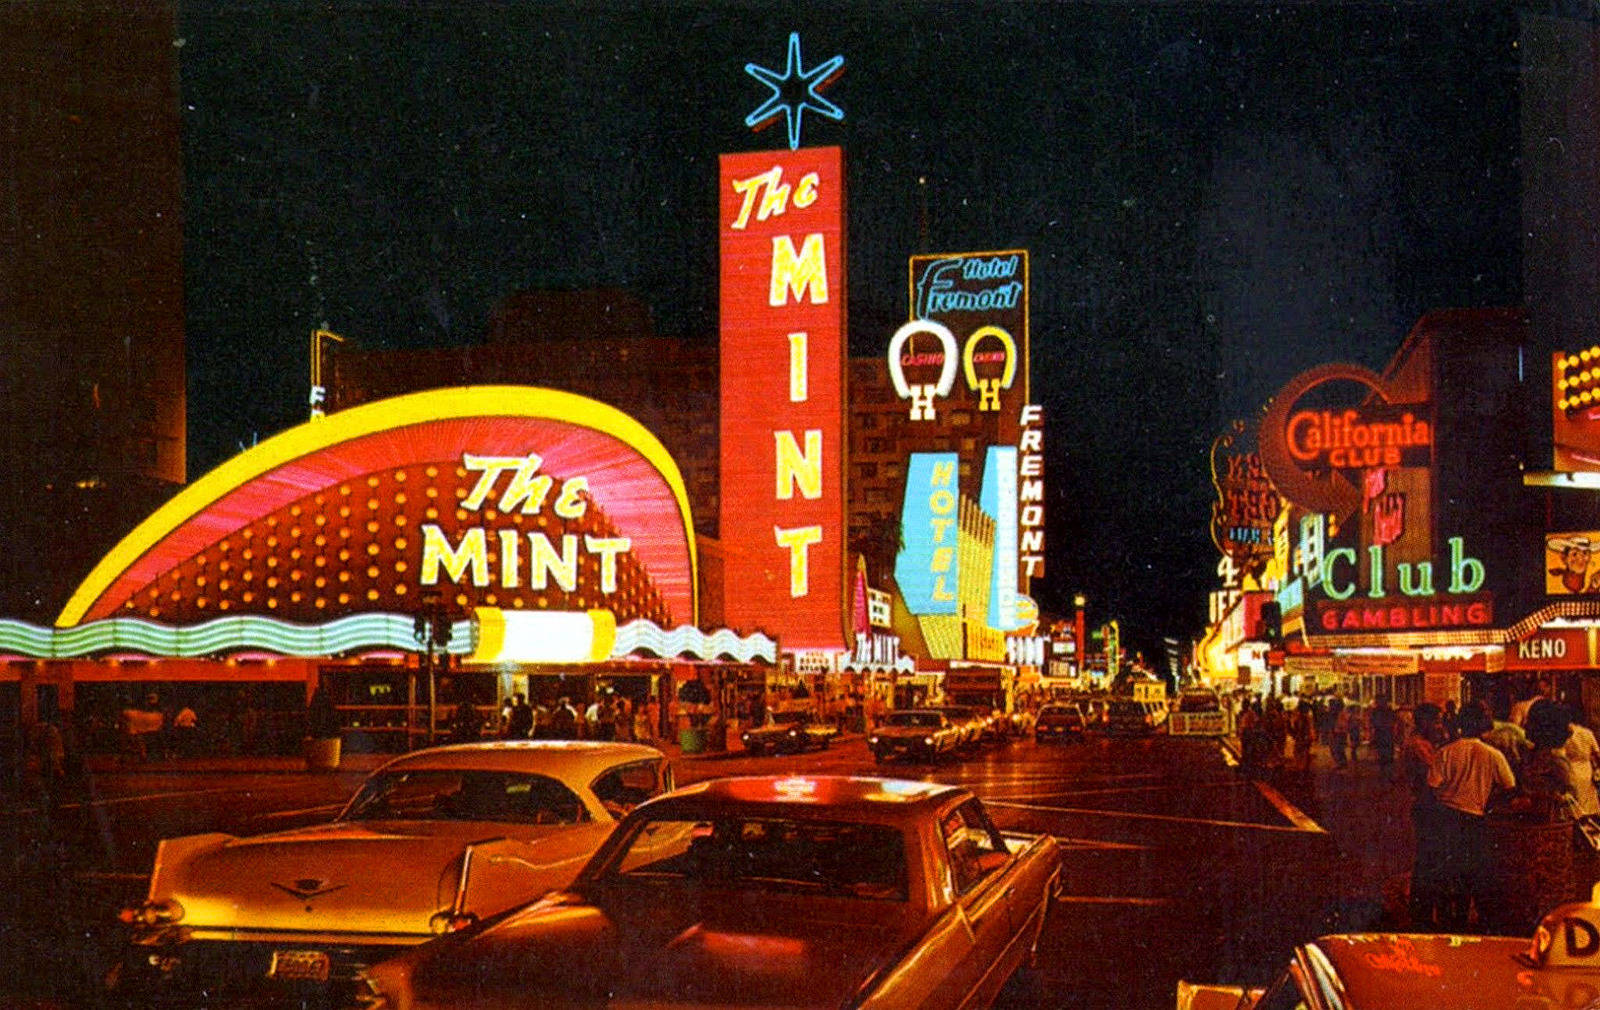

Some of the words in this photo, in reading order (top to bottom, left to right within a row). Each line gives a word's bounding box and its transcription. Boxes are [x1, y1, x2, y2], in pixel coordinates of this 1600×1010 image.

[732, 166, 820, 229] The
[769, 233, 829, 598] MINT
[1286, 409, 1431, 462] California
[461, 452, 588, 518] The
[1329, 447, 1402, 468] CLUB
[1020, 405, 1043, 578] FREMONT
[420, 523, 631, 594] MINT
[929, 461, 956, 603] HOTEL
[1322, 536, 1486, 600] Club
[1321, 602, 1488, 630] GAMBLING
[1519, 638, 1566, 659] KENO
